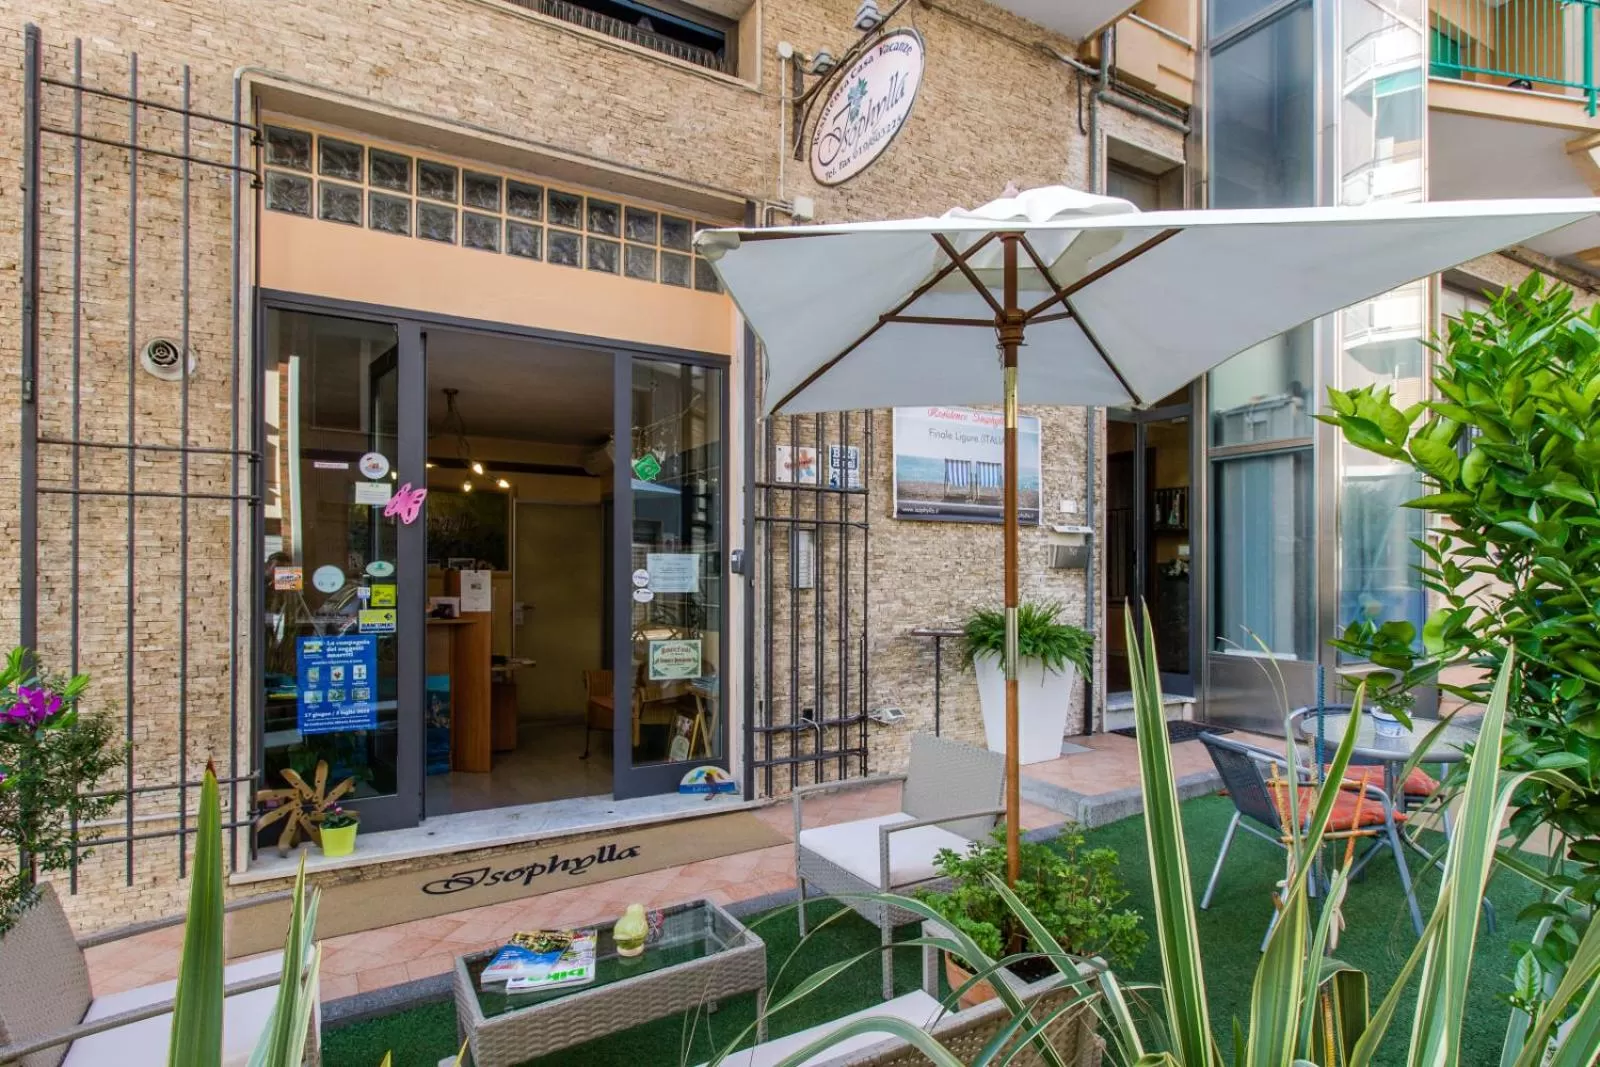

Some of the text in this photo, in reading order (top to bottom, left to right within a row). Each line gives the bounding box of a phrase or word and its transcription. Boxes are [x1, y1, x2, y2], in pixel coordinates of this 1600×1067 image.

[850, 55, 874, 79] Casa
[928, 428, 953, 440] Finale
[955, 431, 979, 444] Ligure
[421, 843, 641, 895] Isophylla
